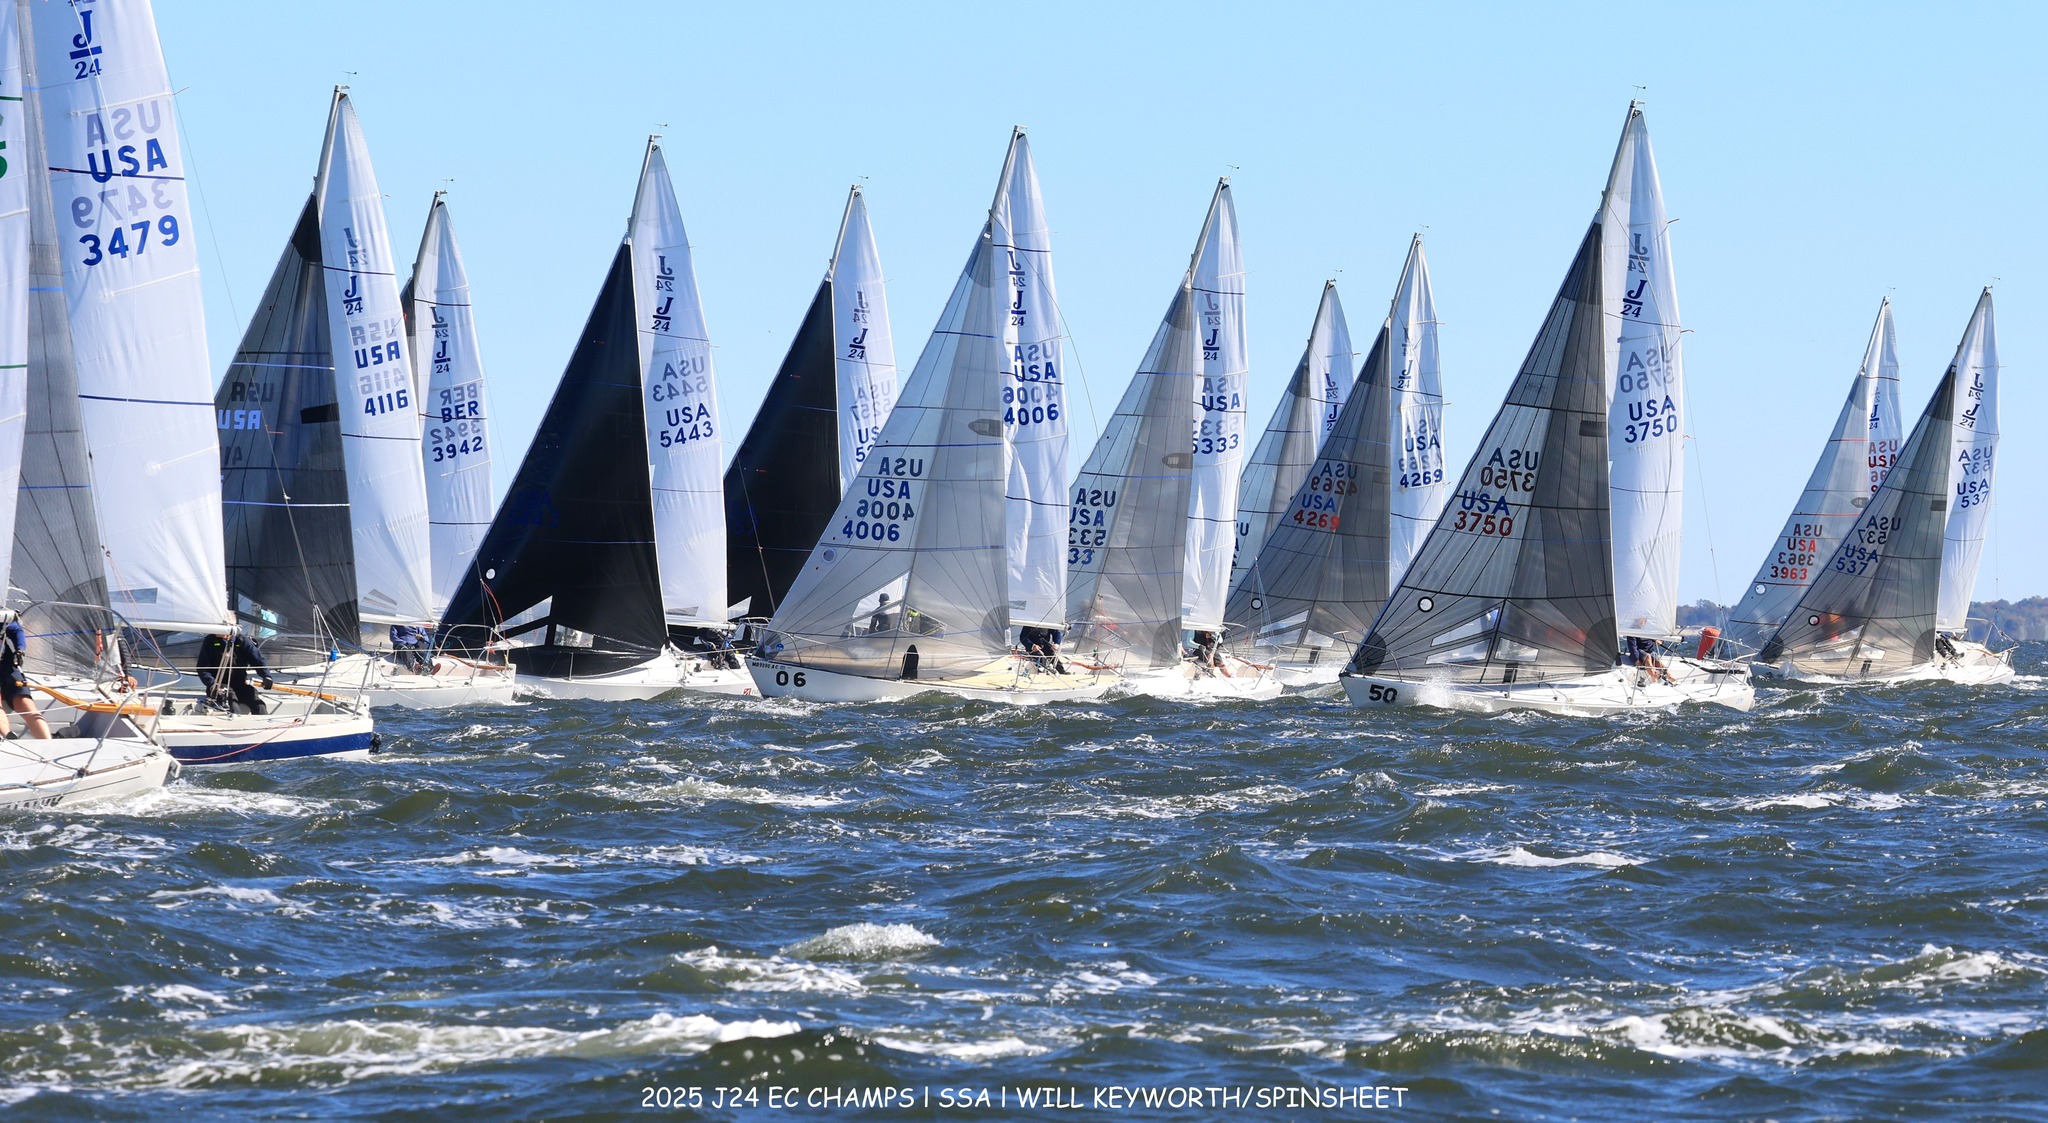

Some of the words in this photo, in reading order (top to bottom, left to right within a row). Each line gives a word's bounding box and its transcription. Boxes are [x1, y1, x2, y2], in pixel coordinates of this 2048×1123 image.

[72, 10, 93, 48] J
[75, 58, 102, 80] 24
[87, 138, 168, 183] USA
[79, 214, 180, 266] 3479
[344, 275, 358, 298] J
[1627, 279, 1647, 300] J
[345, 301, 363, 316] 24
[656, 297, 674, 316] J
[1012, 290, 1024, 310] J
[1620, 304, 1641, 318] 24
[651, 319, 671, 332] 24
[1011, 316, 1025, 326] 24
[852, 328, 869, 345] J
[1205, 328, 1219, 346] J
[354, 340, 401, 369] USA
[436, 340, 447, 359] J
[848, 349, 866, 360] 24
[1203, 351, 1218, 361] 24
[436, 363, 450, 374] 24
[1014, 361, 1057, 383] USA
[1397, 379, 1411, 389] 24
[364, 389, 409, 417] 4116
[1202, 393, 1240, 411] USA
[1628, 395, 1676, 422] USA
[217, 409, 262, 430] USA
[441, 400, 479, 424] BER
[666, 402, 711, 427] USA
[1003, 403, 1059, 426] 4006
[1624, 414, 1678, 444] 3750
[1869, 422, 1878, 430] 24
[1960, 418, 1974, 429] 24
[659, 420, 714, 448] 5443
[858, 425, 880, 444] US
[1405, 434, 1440, 452] USA
[432, 436, 483, 463] 3942
[1868, 453, 1897, 468] USA
[1400, 468, 1443, 488] 4269
[1957, 478, 1989, 495] USA
[867, 478, 911, 500] USA
[1301, 494, 1336, 513] USA
[1461, 490, 1510, 516] USA
[1960, 490, 1989, 509] 537
[1293, 509, 1341, 531] 4269
[1454, 510, 1513, 537] 3750
[842, 520, 900, 542] 4006
[1787, 538, 1817, 552] USA
[1845, 544, 1879, 563] USA
[1068, 548, 1093, 565] 33
[1770, 565, 1808, 580] 3963
[1836, 557, 1868, 576] 537
[776, 671, 806, 687] 06
[1369, 684, 1398, 704] 50
